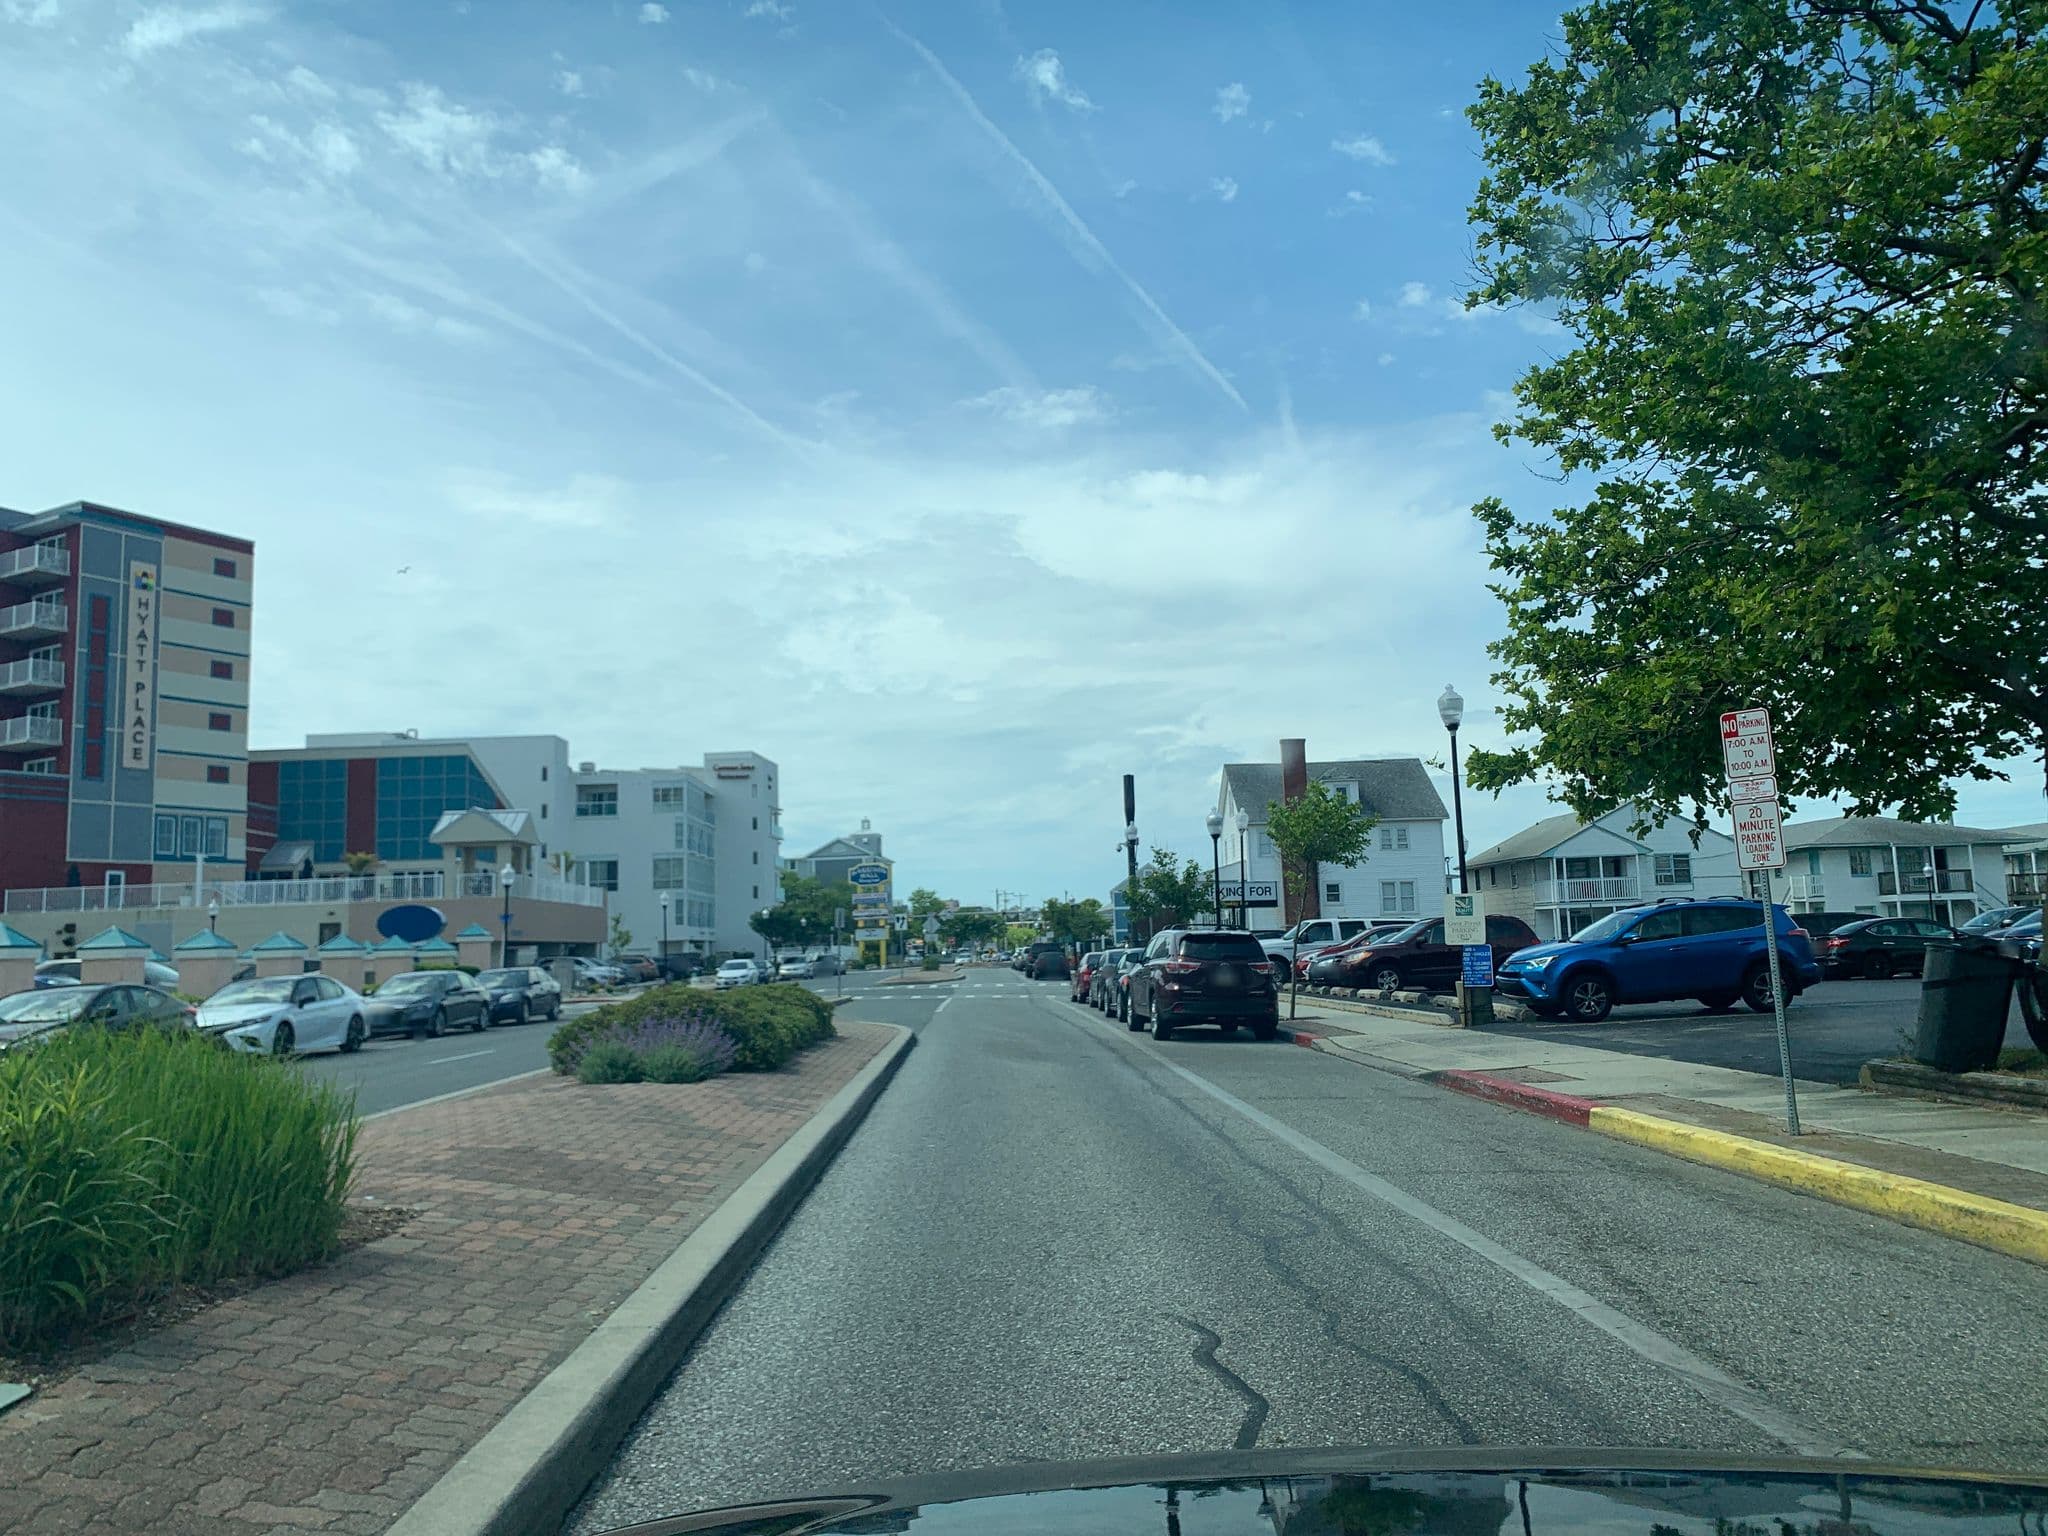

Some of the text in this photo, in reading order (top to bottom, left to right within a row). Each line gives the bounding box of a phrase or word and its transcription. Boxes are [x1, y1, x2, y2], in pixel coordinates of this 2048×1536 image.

[132, 598, 149, 761] HYATT PLACE
[1723, 717, 1765, 733] NO PARKING
[1727, 735, 1768, 748] 7:00 A.M.
[1743, 749, 1754, 758] TO
[1731, 759, 1770, 771] 10:00 A.M.
[1749, 808, 1763, 819] 20
[1739, 819, 1776, 832] MINUTE
[1741, 831, 1777, 844] PARKING
[1745, 842, 1775, 854] LOADING
[1752, 851, 1771, 863] ZONE
[1249, 886, 1272, 896] FOR
